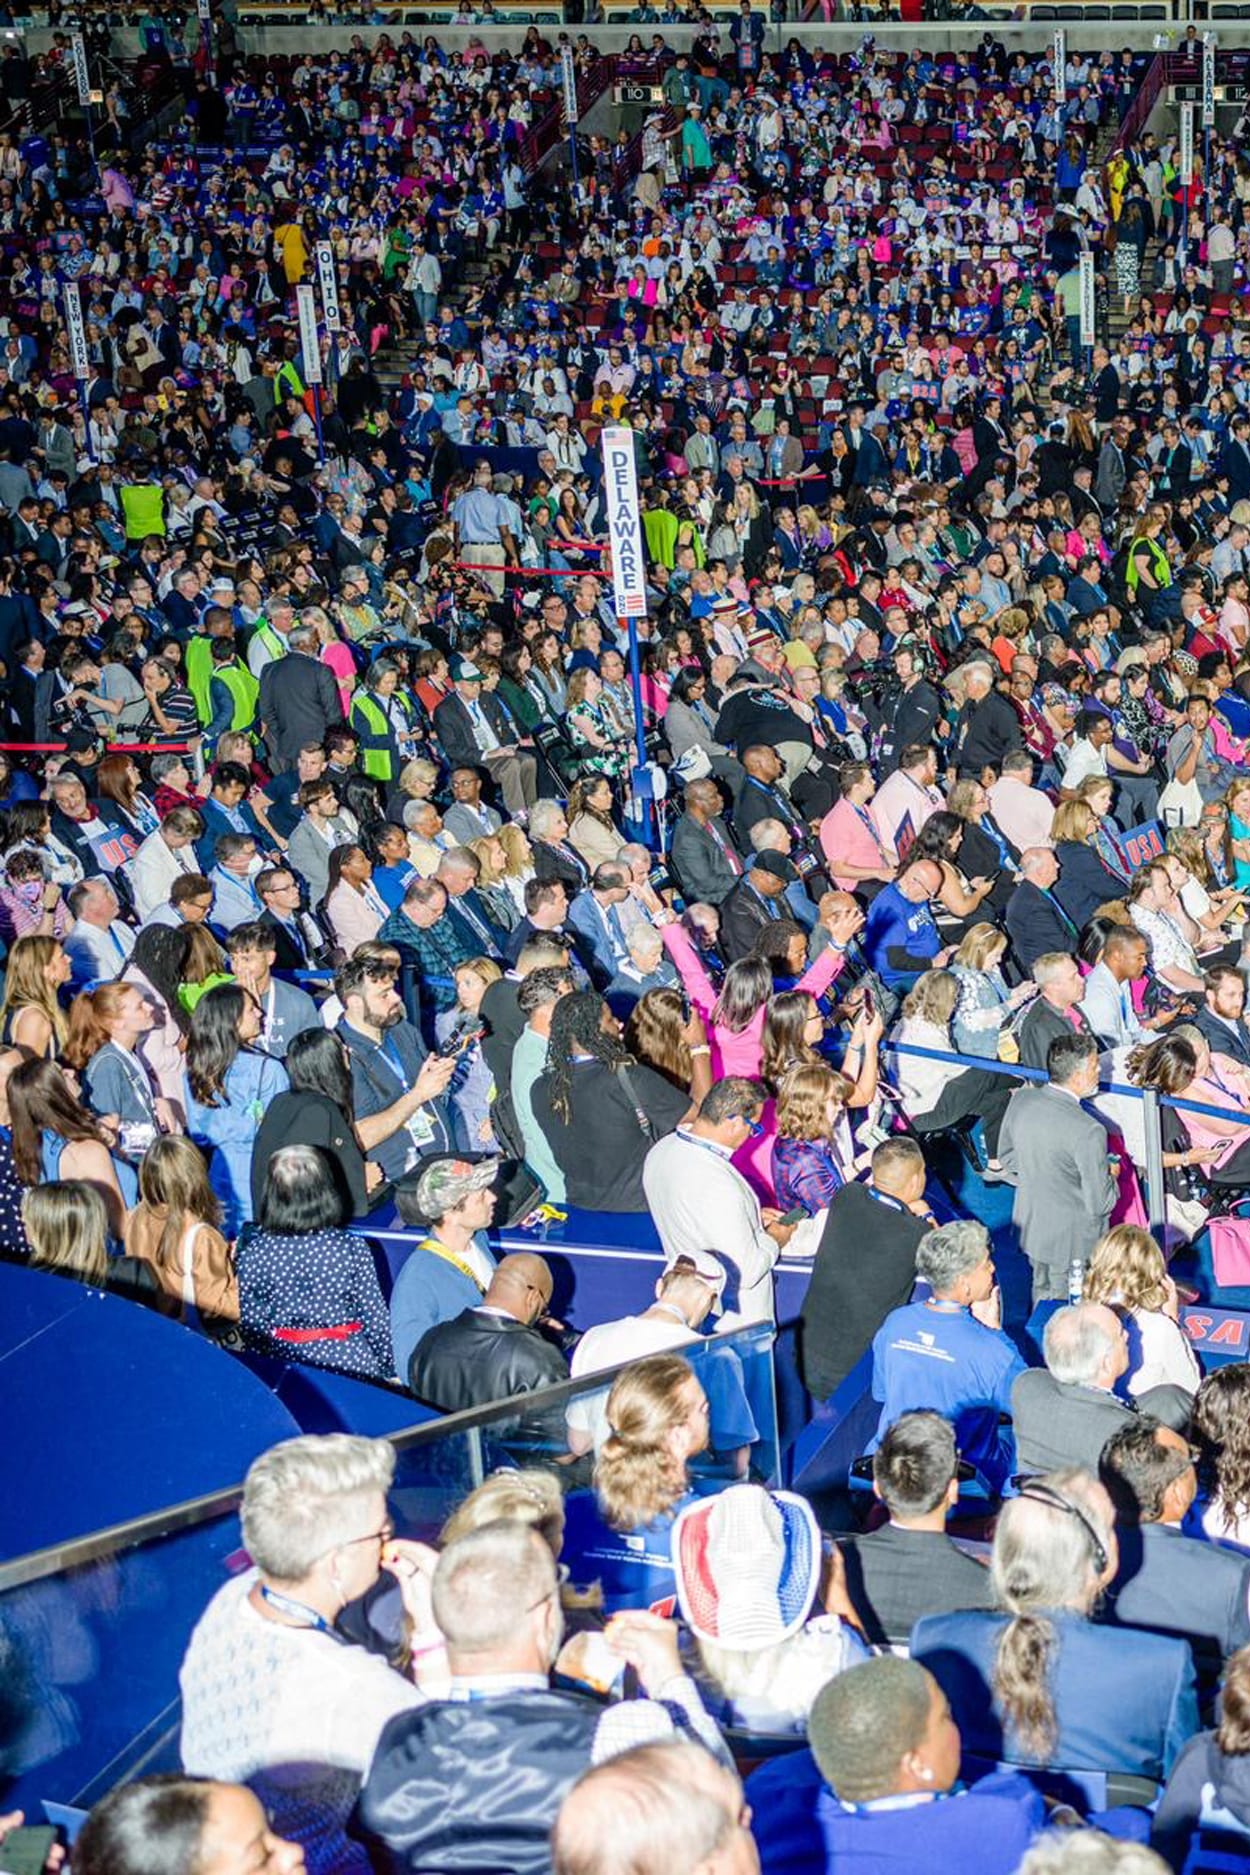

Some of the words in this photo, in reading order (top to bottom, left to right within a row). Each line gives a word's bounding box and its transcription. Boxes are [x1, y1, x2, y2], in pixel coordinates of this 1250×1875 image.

[75, 41, 88, 96] COLORADO
[1205, 54, 1213, 112] ALABAMA
[627, 88, 644, 100] 110
[320, 251, 337, 318] OHIO
[70, 294, 80, 322] NEW
[74, 327, 86, 366] YORK
[611, 451, 637, 589] DELAWARE
[1126, 829, 1164, 867] USA
[1183, 1315, 1244, 1345] SA
